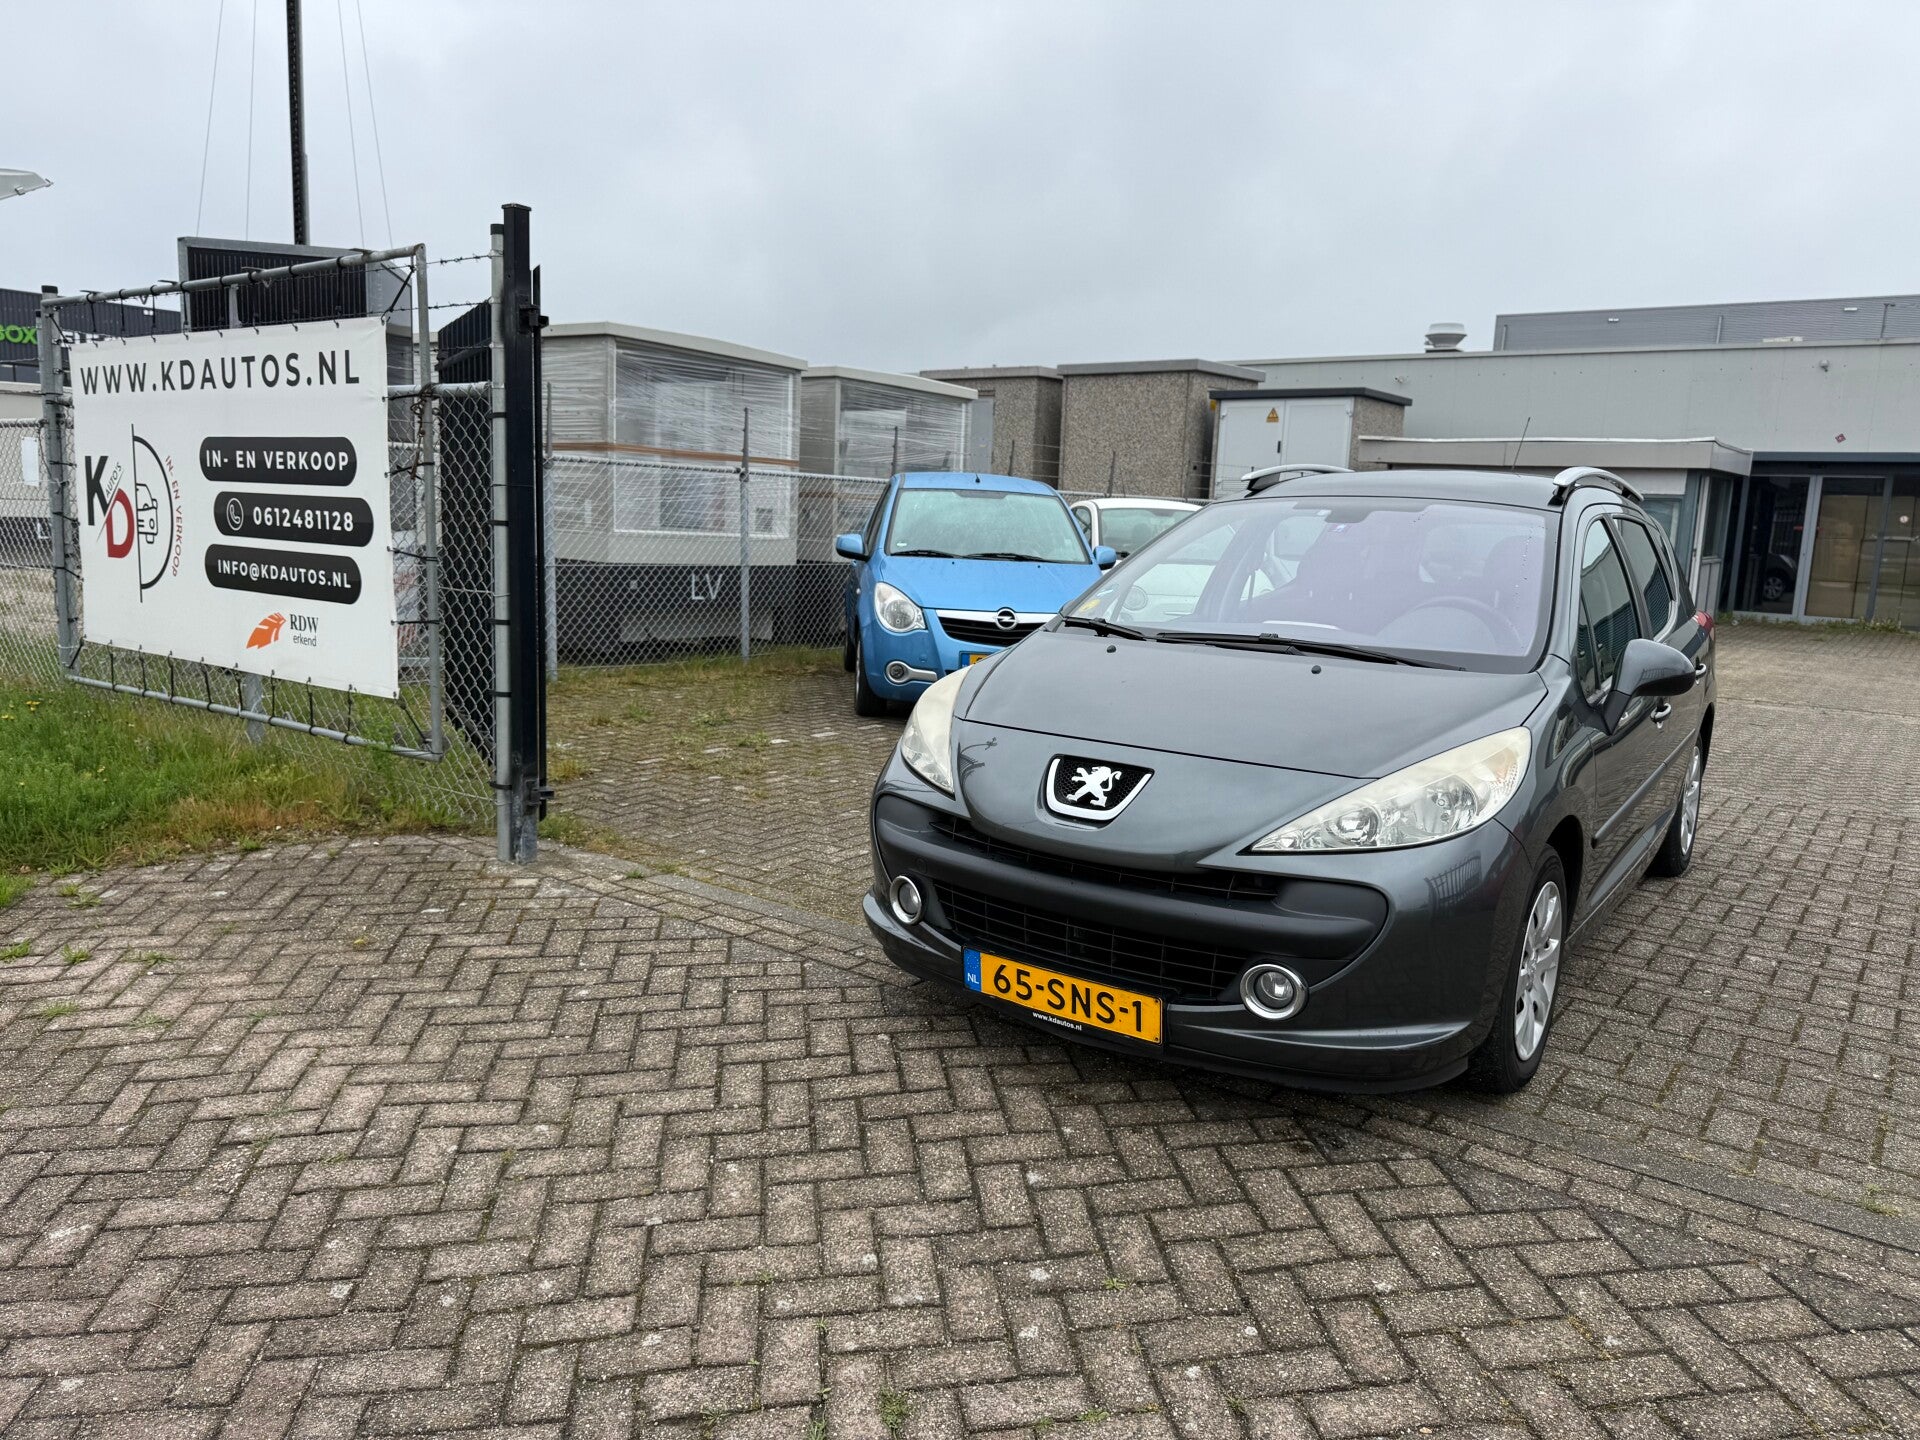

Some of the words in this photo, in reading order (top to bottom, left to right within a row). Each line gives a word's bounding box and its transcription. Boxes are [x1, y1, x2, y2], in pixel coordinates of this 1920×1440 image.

[80, 350, 360, 395] WWW.KDAUTOS.NL
[165, 455, 174, 477] IN-
[206, 450, 228, 468] IN-
[236, 450, 256, 469] EN
[263, 451, 349, 471] VERKOOP
[105, 461, 122, 498] AUTO'S
[171, 480, 180, 500] EN
[253, 506, 354, 532] 0612481128
[172, 505, 183, 577] VERKOOP
[218, 559, 352, 589] INFO@KDAUTOS.NL
[691, 573, 723, 600] LV
[289, 613, 319, 633] RDW
[292, 634, 317, 647] erkend
[967, 972, 980, 985] NL
[993, 964, 1143, 1032] 65-SNS-1
[1032, 1011, 1082, 1031] www.kdautos.nl
